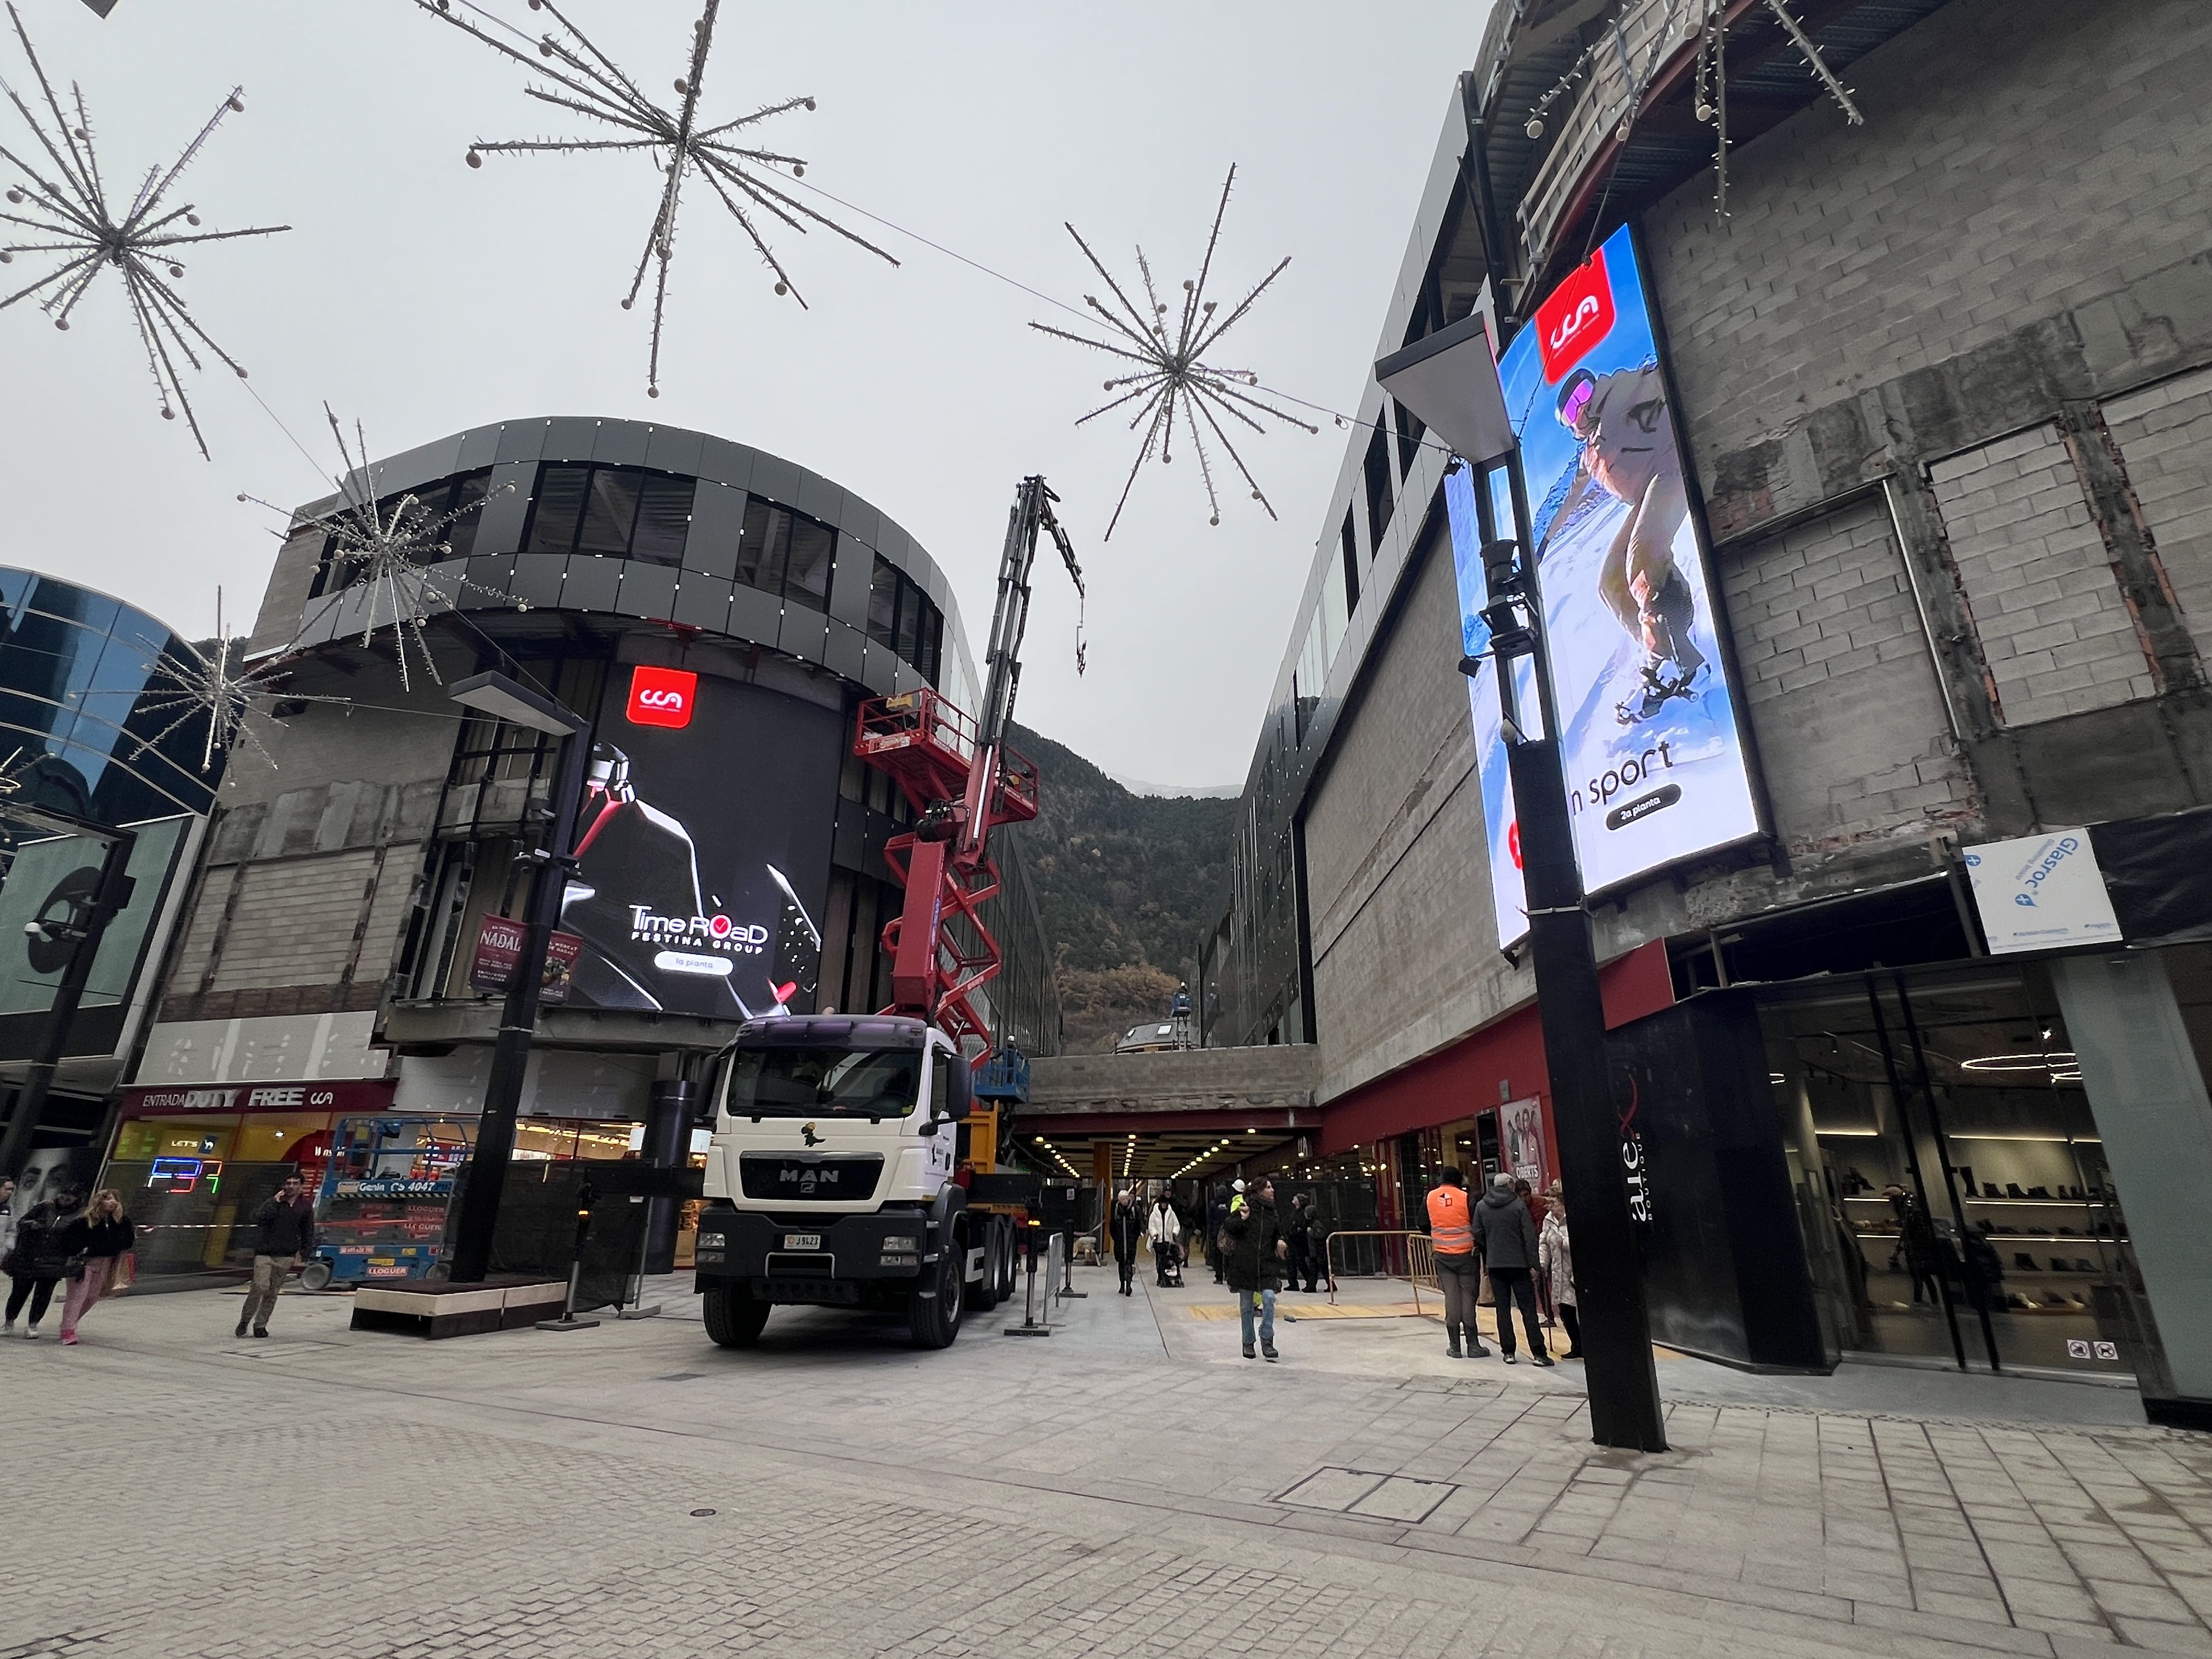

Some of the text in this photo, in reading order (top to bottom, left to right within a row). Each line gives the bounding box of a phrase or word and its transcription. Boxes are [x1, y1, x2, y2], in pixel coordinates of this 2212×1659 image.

[1589, 741, 1673, 806] sport
[1621, 796, 1661, 820] 2a planta
[2025, 837, 2079, 888] Glasroc
[479, 930, 521, 951] NADAL
[631, 932, 763, 955] FESTINA GROUP
[685, 959, 713, 969] planta
[143, 1093, 184, 1107] ENTRADA
[183, 1089, 241, 1108] DUTY
[248, 1087, 306, 1106] FREE
[780, 1170, 839, 1182] MAN
[1516, 1164, 1538, 1179] OBERTS
[408, 1182, 436, 1192] 4047
